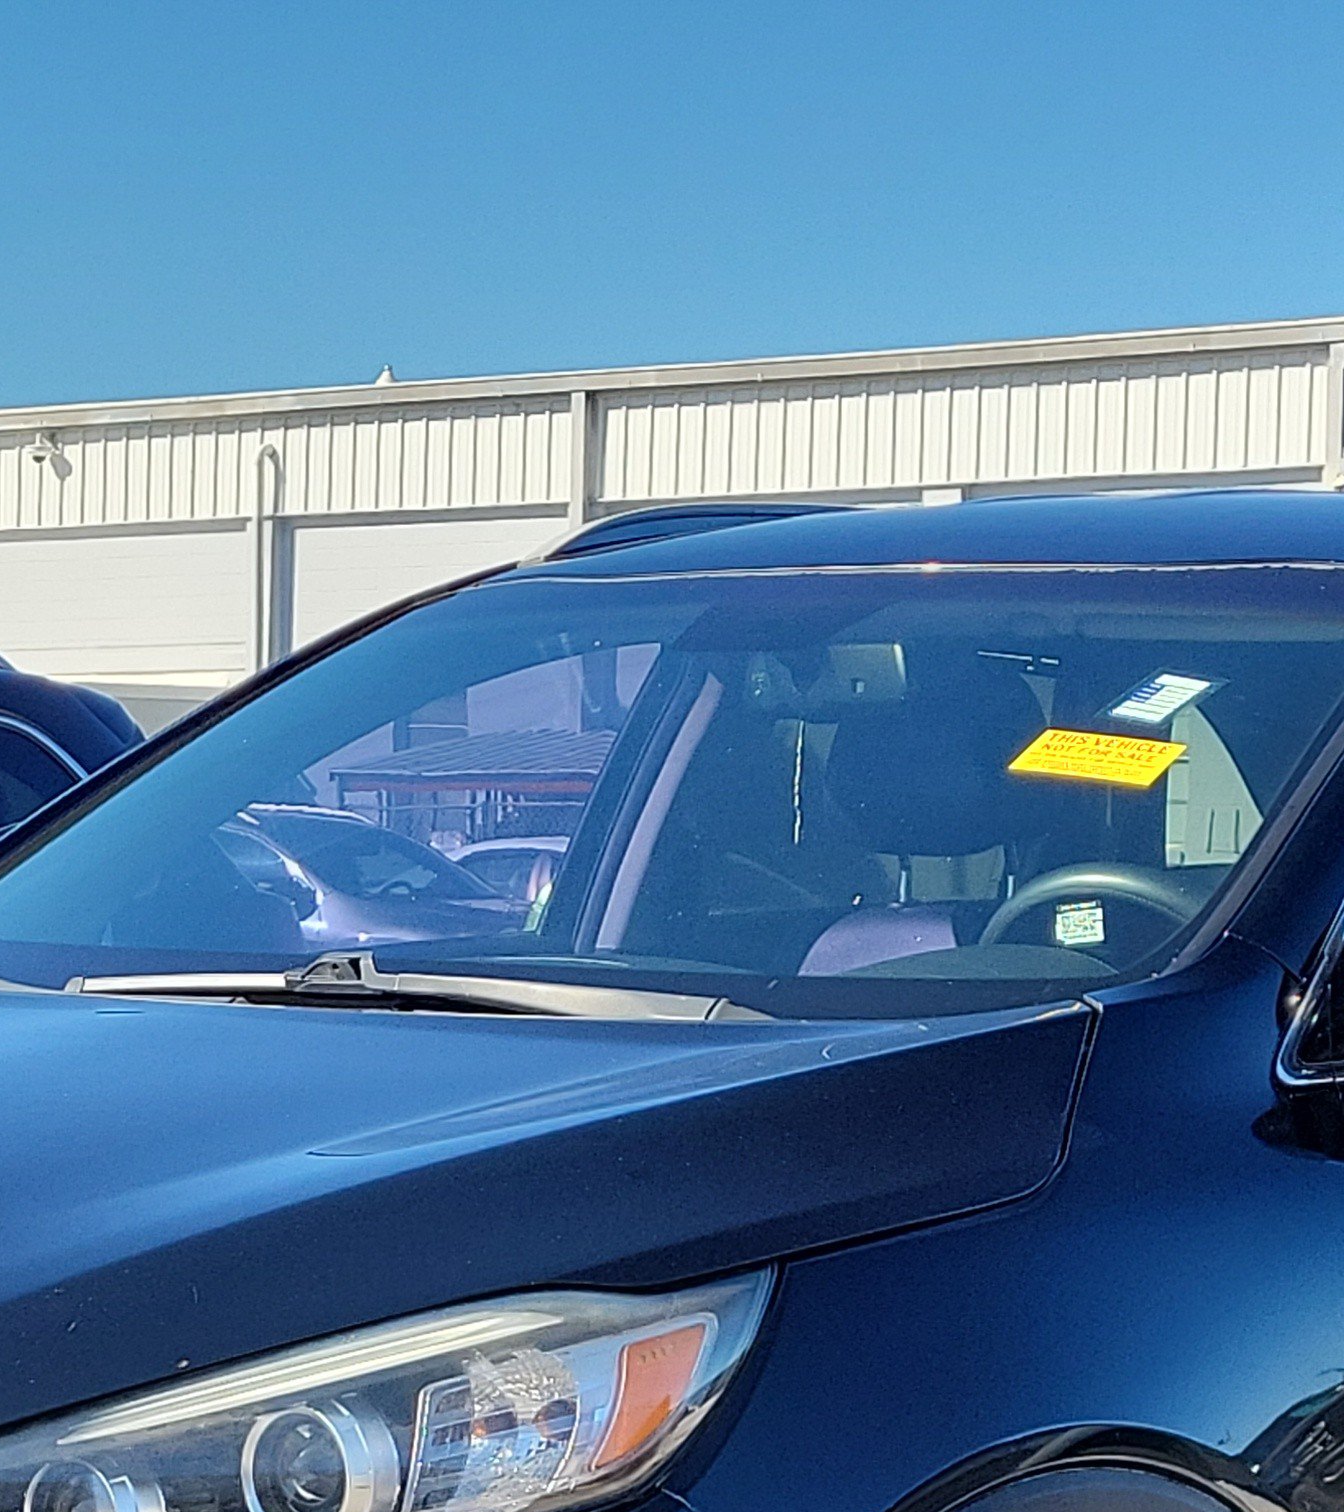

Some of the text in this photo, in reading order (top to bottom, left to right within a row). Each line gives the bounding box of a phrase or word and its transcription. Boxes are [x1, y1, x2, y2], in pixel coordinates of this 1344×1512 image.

[1041, 742, 1077, 753] NOT
[1079, 746, 1110, 758] FOR
[1118, 752, 1158, 763] SALE
[1047, 732, 1172, 755] THIS VEHICLE
